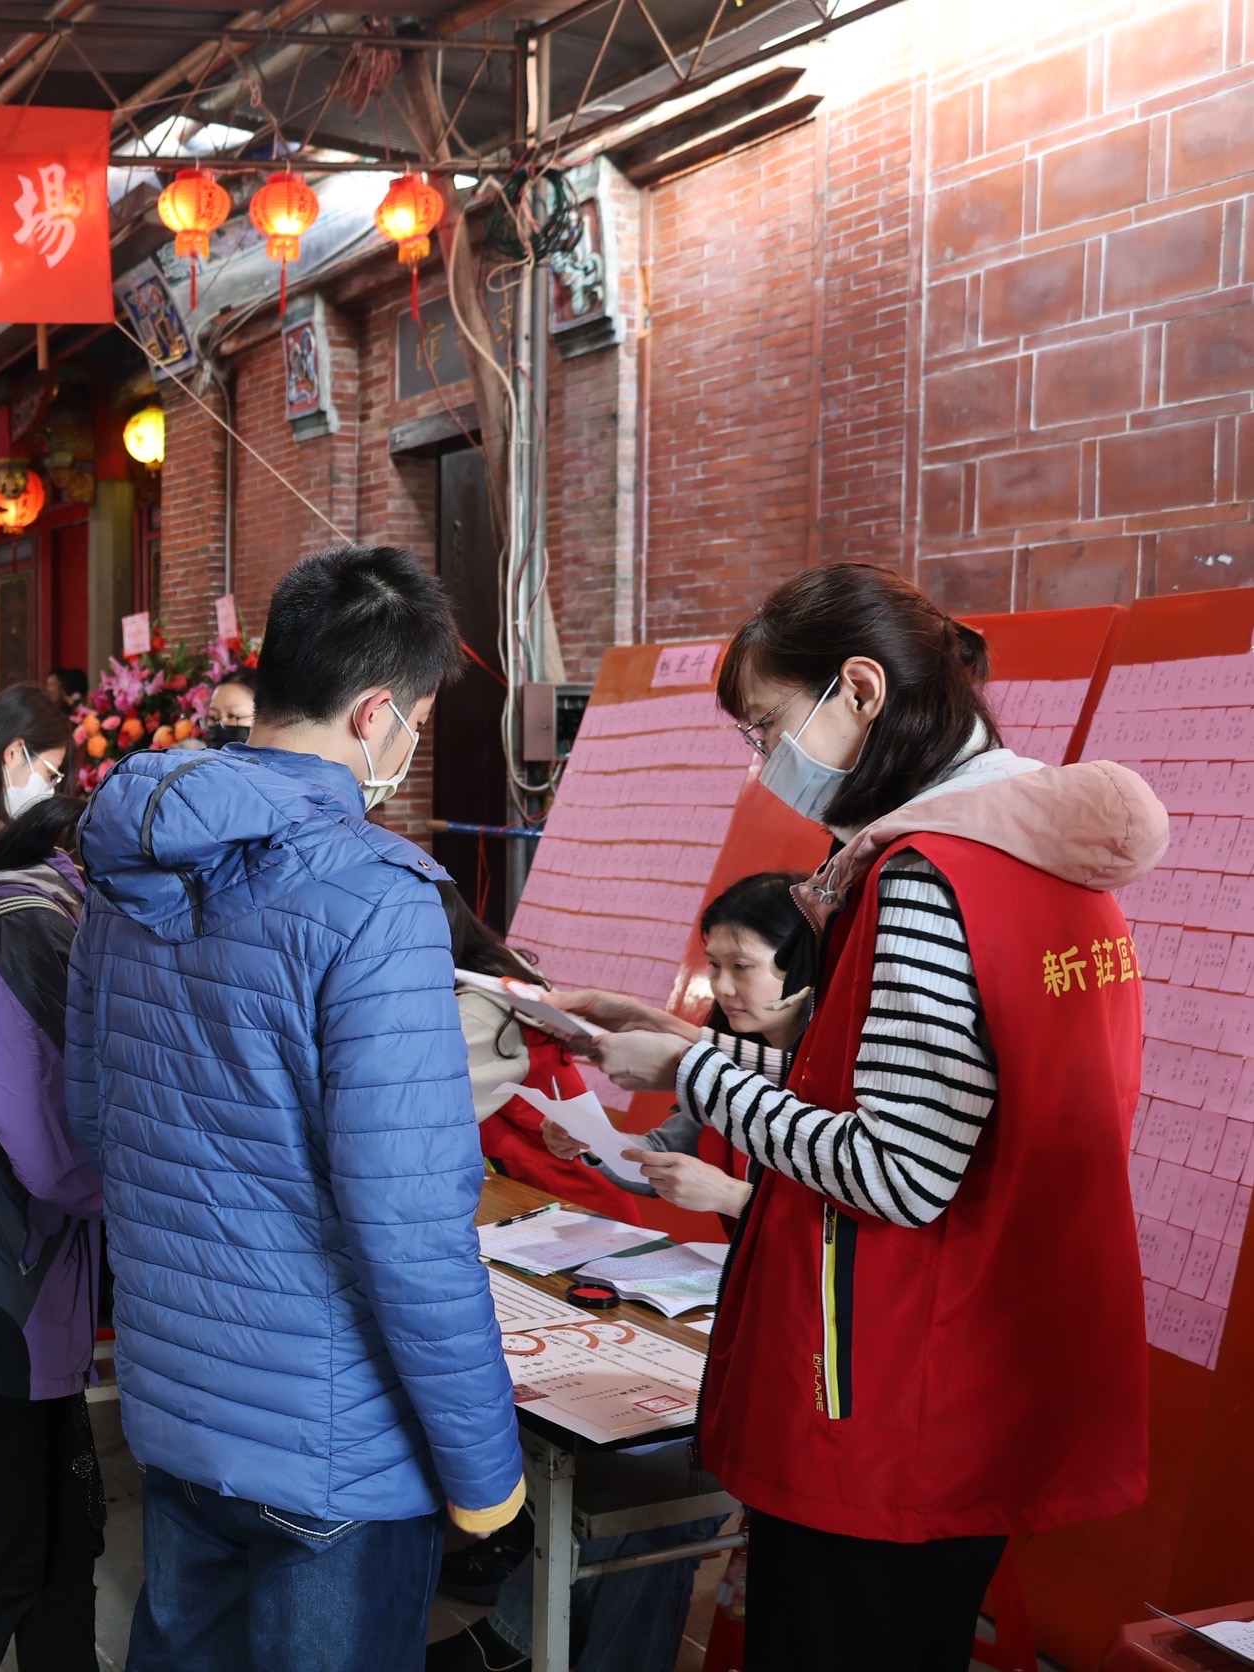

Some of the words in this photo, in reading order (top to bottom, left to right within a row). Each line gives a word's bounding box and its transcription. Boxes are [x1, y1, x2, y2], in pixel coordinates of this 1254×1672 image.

[1042, 934, 1142, 998] 新莊區
[814, 1366, 824, 1412] FLARE
